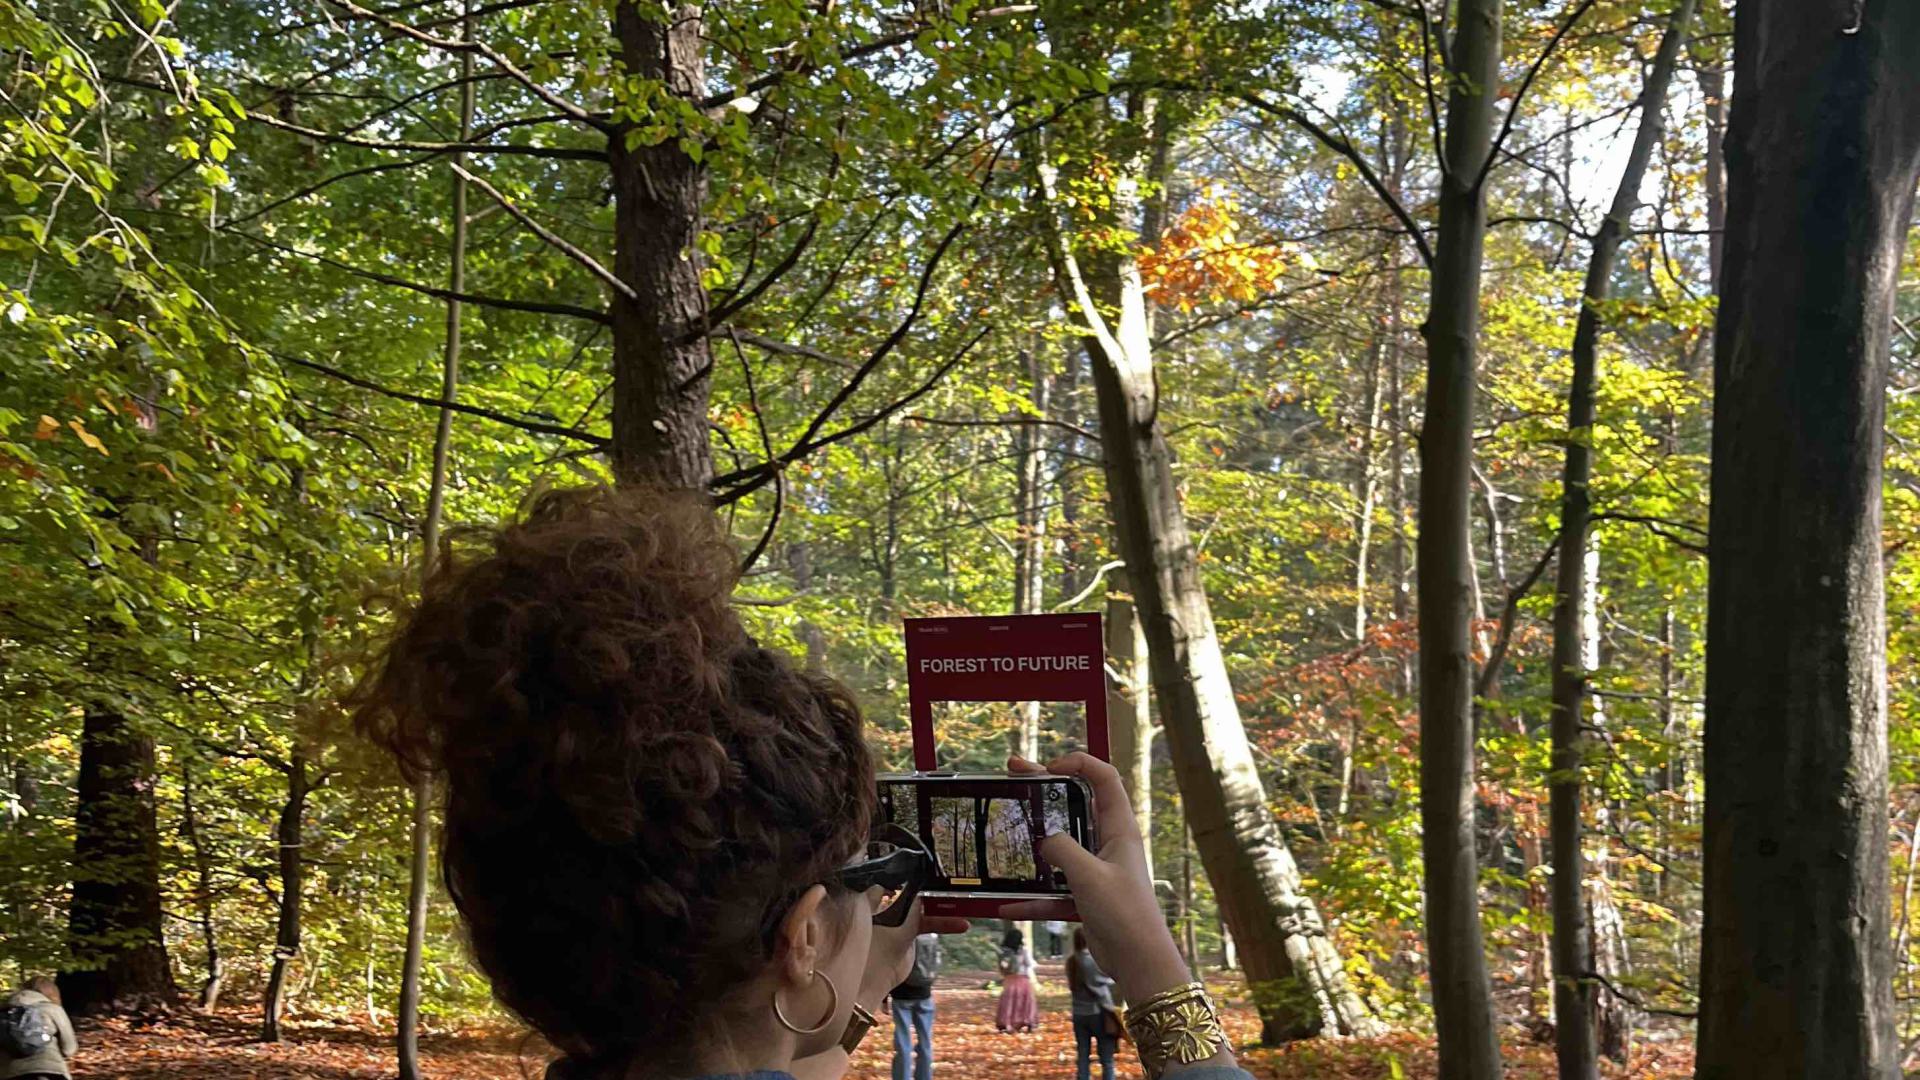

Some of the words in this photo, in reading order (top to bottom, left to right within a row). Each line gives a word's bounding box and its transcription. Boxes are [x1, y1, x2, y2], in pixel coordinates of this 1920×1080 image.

[920, 658, 987, 673] FOREST
[990, 657, 1014, 672] TO
[1018, 655, 1090, 671] FUTURE
